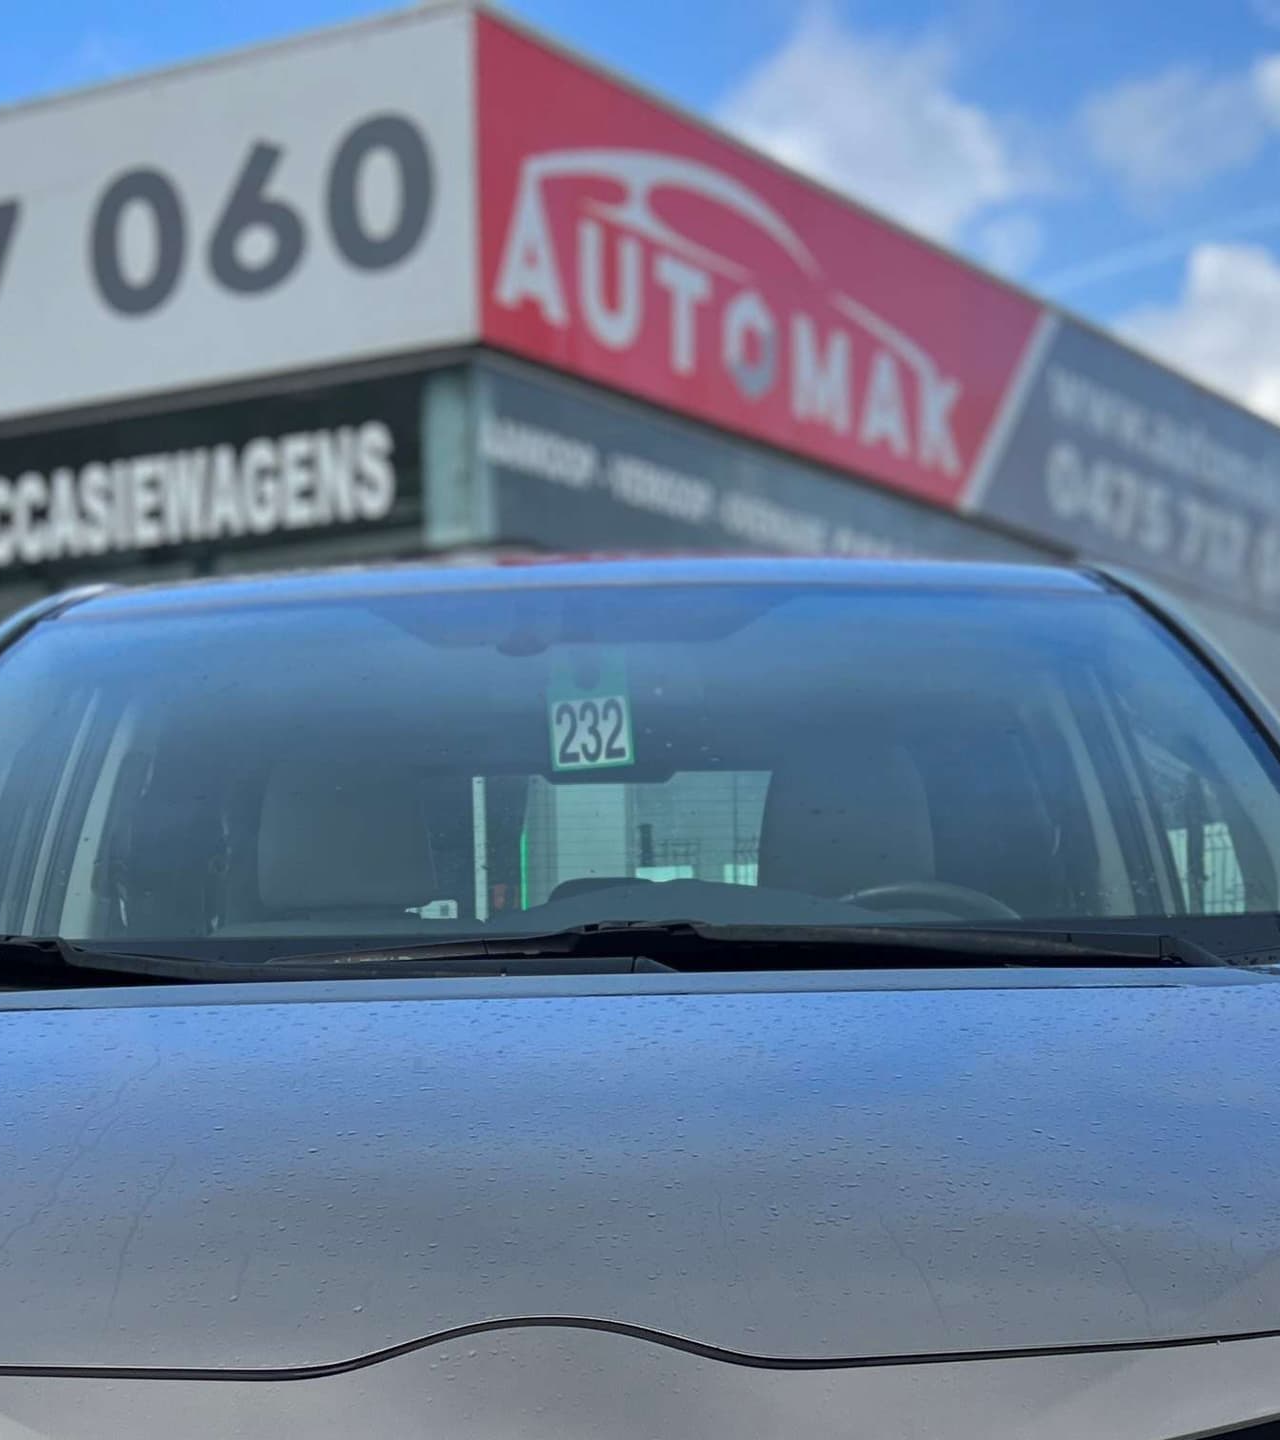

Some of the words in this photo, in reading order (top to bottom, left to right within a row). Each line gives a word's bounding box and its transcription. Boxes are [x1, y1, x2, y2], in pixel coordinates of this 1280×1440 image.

[88, 111, 435, 317] 060
[495, 172, 962, 478] AUTOMAK
[553, 698, 628, 766] 232
